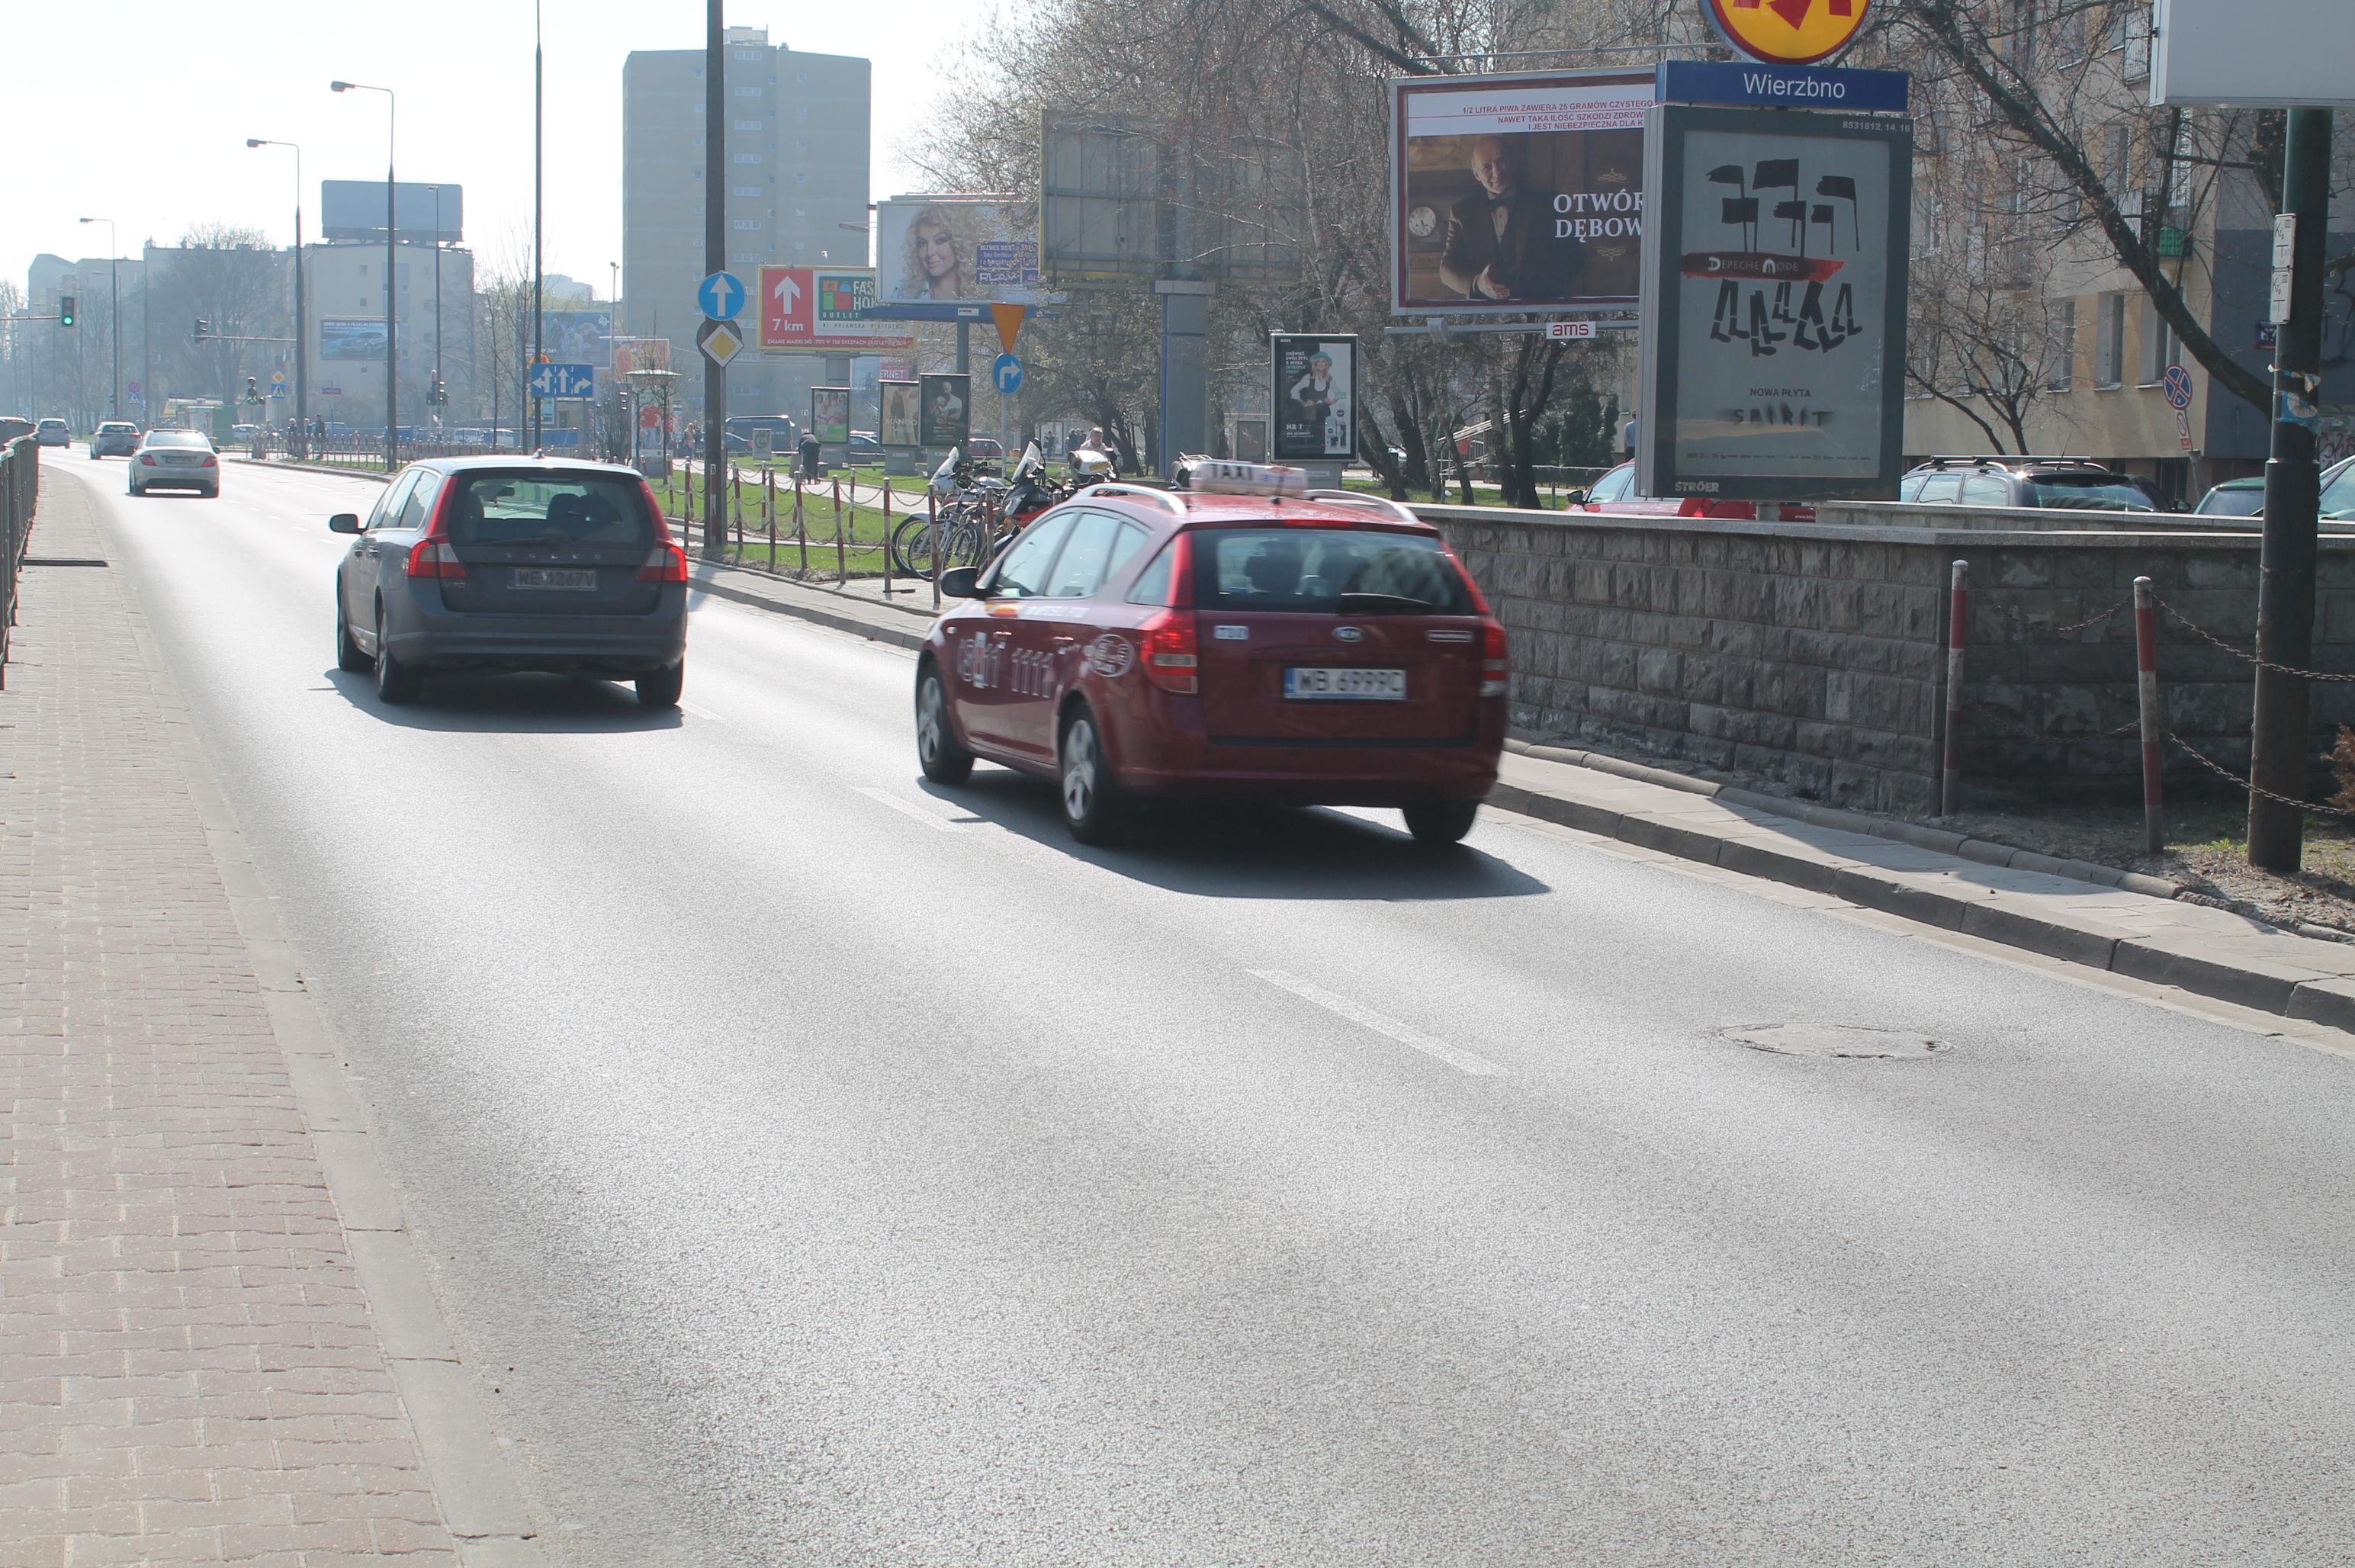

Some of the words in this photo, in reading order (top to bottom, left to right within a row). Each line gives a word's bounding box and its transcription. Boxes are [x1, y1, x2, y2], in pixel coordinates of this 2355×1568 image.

[1743, 72, 1846, 98] Wierzbno
[1476, 105, 1498, 114] LITRA
[1499, 104, 1520, 113] PIWA
[1521, 103, 1557, 112] ZAWIERA
[1559, 102, 1568, 111] 25
[1569, 100, 1608, 110] GRAMÓW
[1609, 100, 1653, 108] CZYSTEGO
[1498, 115, 1525, 124] NAWET
[1550, 112, 1574, 121] ILOŚĆ
[1554, 120, 1618, 130] NIEBEZPIECZNA
[1620, 119, 1637, 127] DLA
[1900, 124, 1910, 133] 16
[1555, 217, 1642, 243] DĘBOW
[1708, 256, 1759, 272] DEPECHE
[1762, 259, 1799, 275] MODE
[772, 319, 781, 332] 7
[784, 319, 804, 332] km
[1552, 323, 1589, 336] ams
[1749, 387, 1780, 397] NOWA
[1782, 388, 1811, 398] PŁYTA
[1209, 463, 1253, 481] TAXI
[1674, 480, 1720, 493] STRÖER
